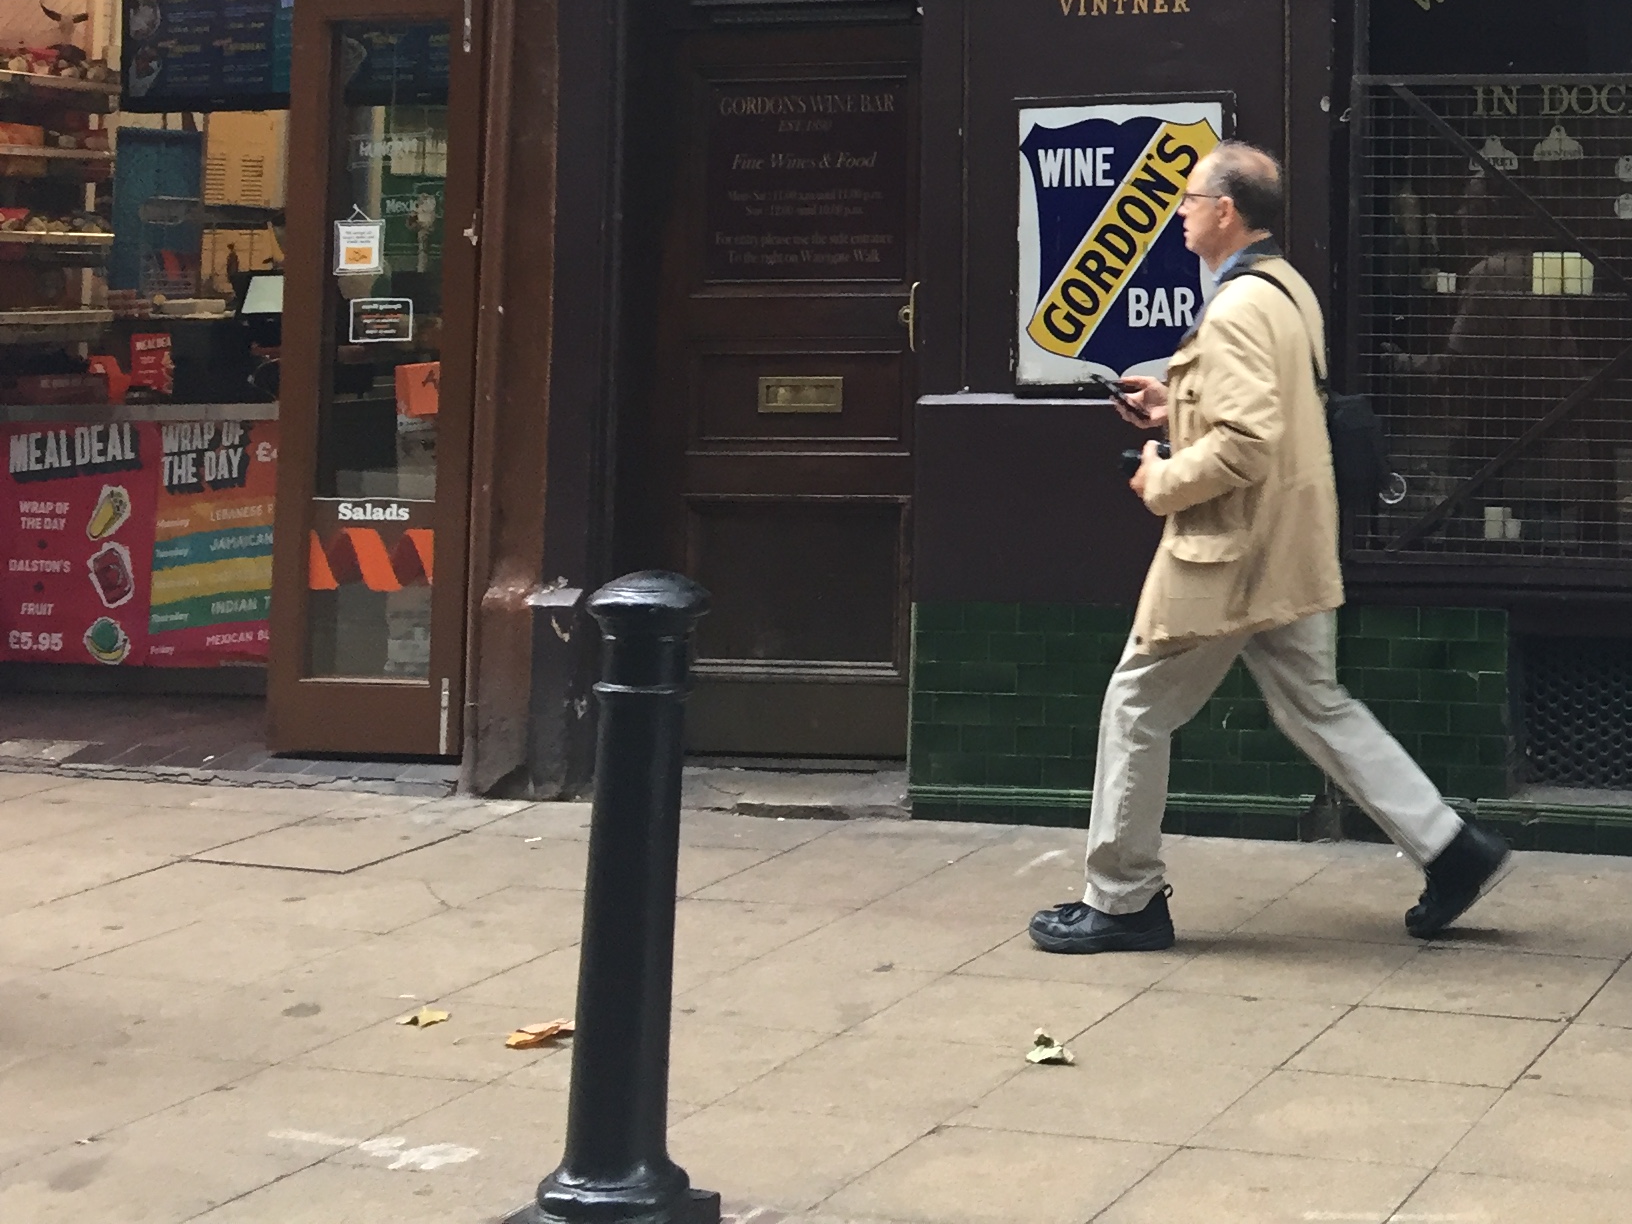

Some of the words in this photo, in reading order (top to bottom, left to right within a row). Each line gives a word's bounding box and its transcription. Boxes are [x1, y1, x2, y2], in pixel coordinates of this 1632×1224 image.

[720, 94, 807, 116] GORDON'S
[810, 94, 856, 114] WINE
[860, 93, 895, 113] BAR
[1473, 84, 1519, 117] IN
[731, 153, 765, 171] Fine
[770, 152, 817, 170] Wines
[819, 153, 831, 169] &
[835, 151, 878, 169] Food
[1037, 146, 1115, 188] WINE
[1043, 133, 1199, 344] GORDON'S
[1128, 286, 1196, 327] BAR
[9, 430, 72, 474] MEAL
[74, 422, 137, 467] DEAL
[161, 421, 215, 454] WRAP
[221, 421, 245, 447] OF
[161, 456, 199, 487] THE
[204, 447, 243, 482] DAY
[19, 500, 54, 515] WRAP
[55, 500, 70, 515] OF
[337, 502, 410, 521] Salads
[20, 517, 42, 530] THE
[43, 517, 67, 531] DAY
[8, 559, 71, 573] DALSTON'S
[20, 603, 54, 616] FRUIT
[8, 631, 63, 651] £5.95
[206, 631, 254, 647] MEXICAN
